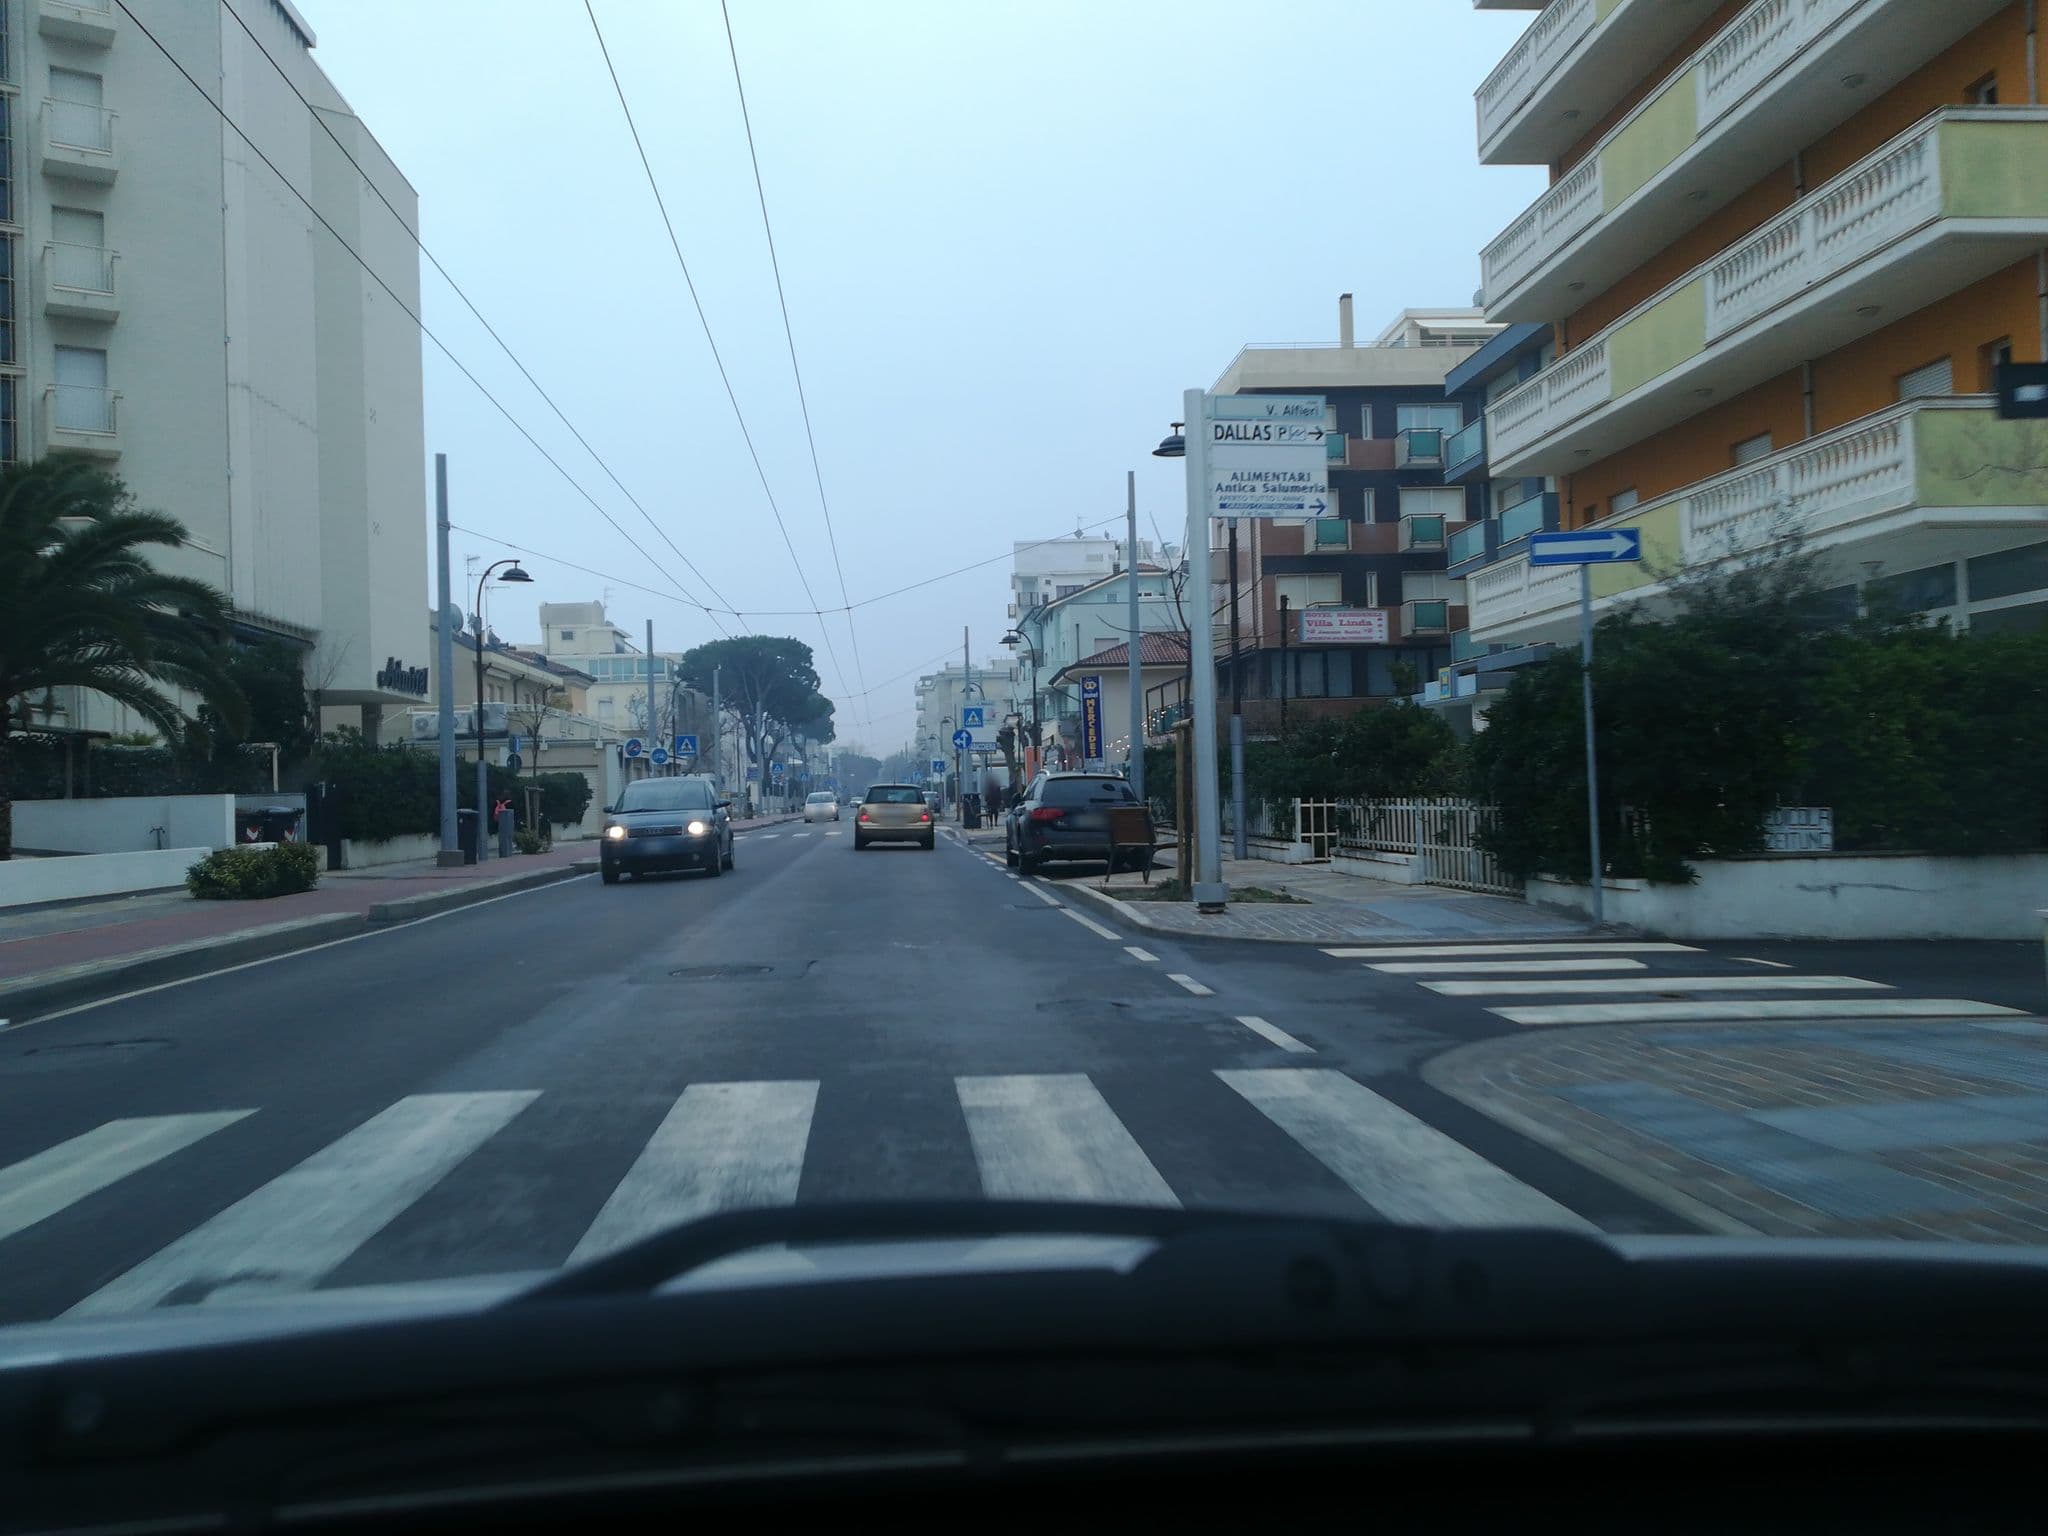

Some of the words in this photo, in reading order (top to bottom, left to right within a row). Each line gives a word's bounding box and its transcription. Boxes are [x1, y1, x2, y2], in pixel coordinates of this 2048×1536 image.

[1266, 404, 1278, 416] V.
[1283, 404, 1319, 416] Alfieri
[1214, 424, 1271, 440] DALLAS
[1231, 471, 1311, 482] ALIMENTARI
[1215, 483, 1256, 493] Antica
[1262, 483, 1326, 494] Salumeria
[1306, 619, 1333, 627] Villa
[1339, 618, 1373, 627] Linda
[1087, 699, 1097, 757] MERCEDES
